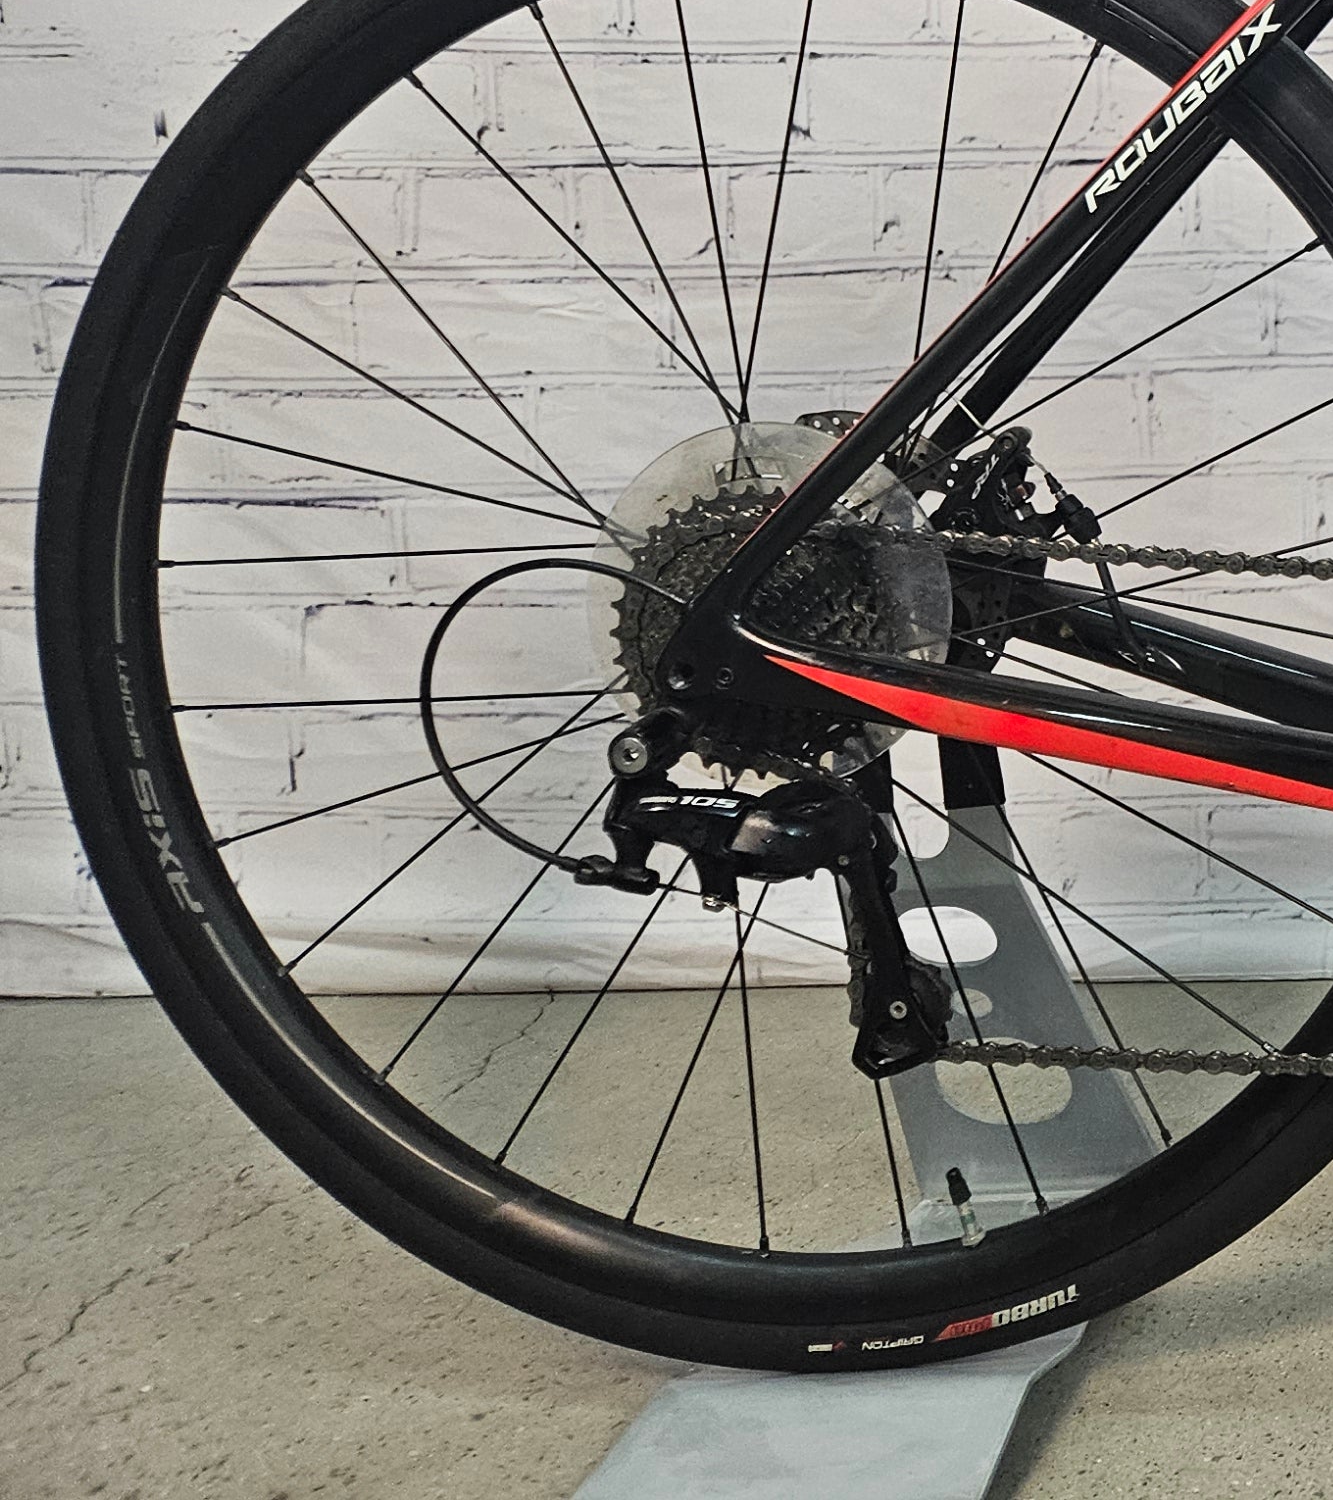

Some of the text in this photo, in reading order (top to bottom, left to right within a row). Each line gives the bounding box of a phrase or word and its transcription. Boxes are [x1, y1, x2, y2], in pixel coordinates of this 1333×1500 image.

[971, 454, 999, 500] TRP
[680, 795, 740, 809] 105
[992, 1284, 1080, 1328] TURBO
